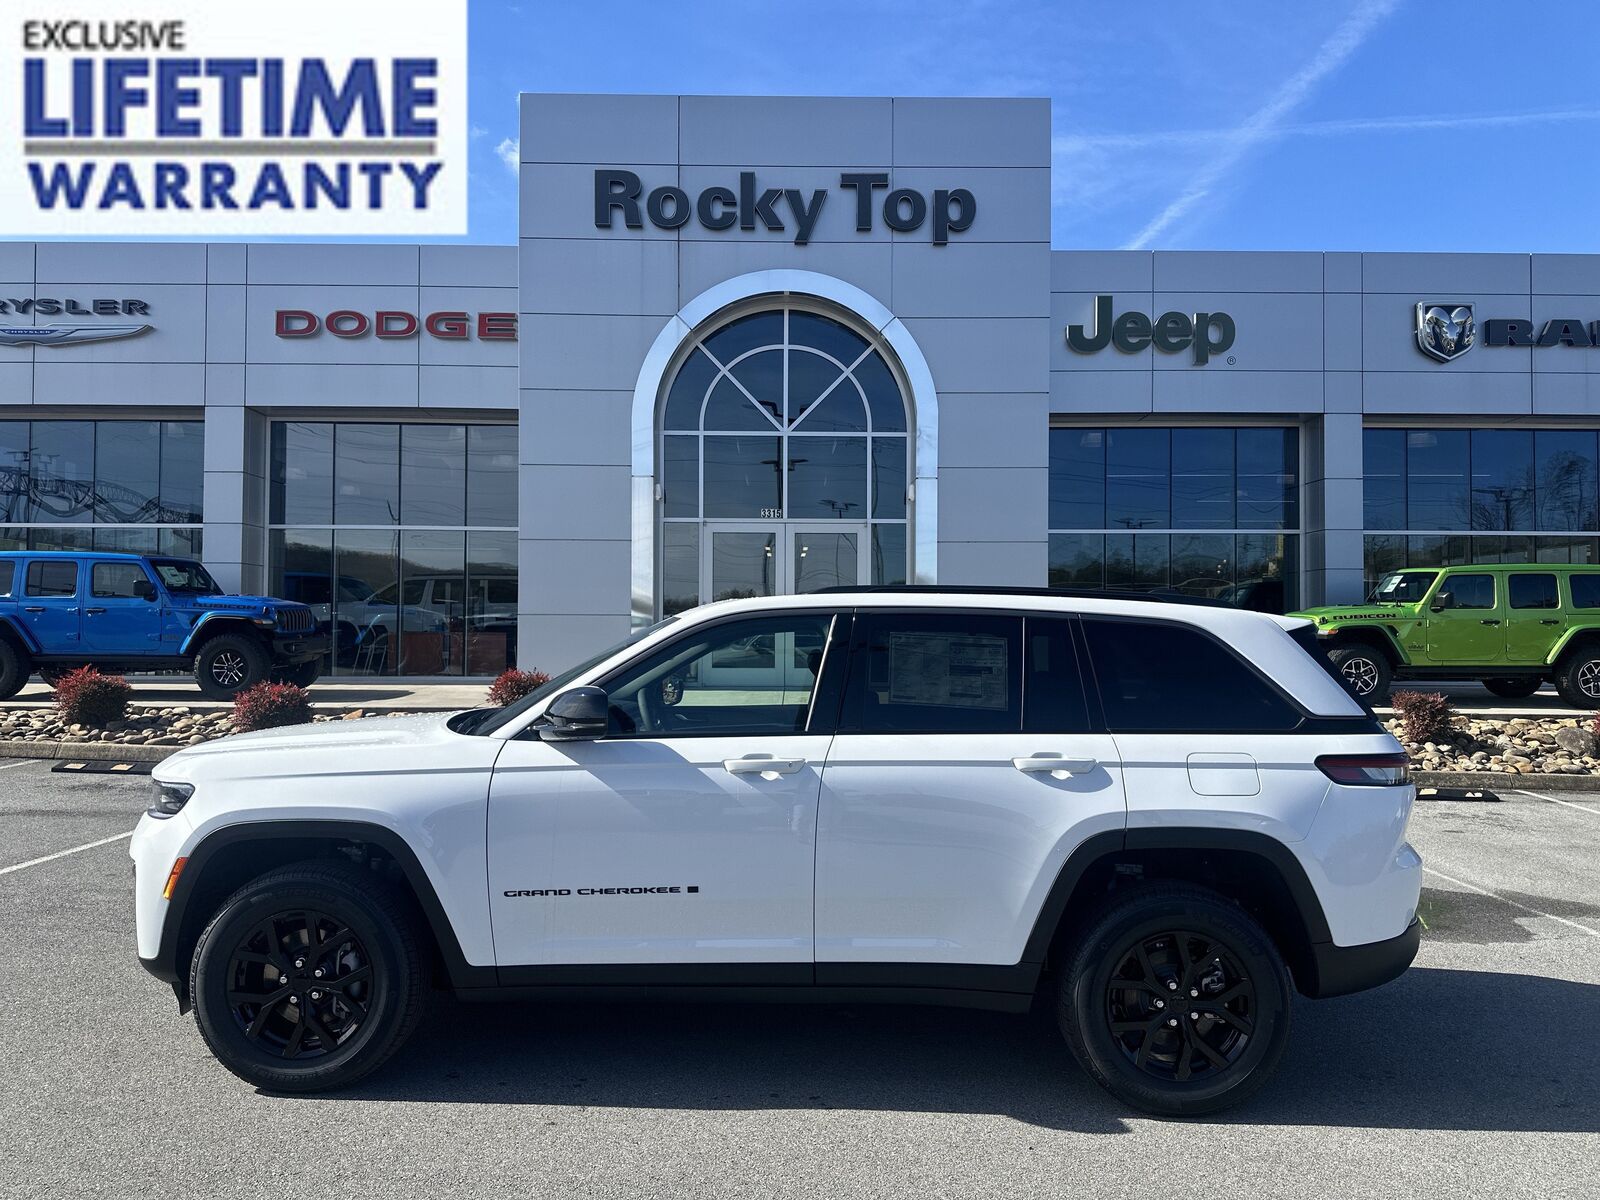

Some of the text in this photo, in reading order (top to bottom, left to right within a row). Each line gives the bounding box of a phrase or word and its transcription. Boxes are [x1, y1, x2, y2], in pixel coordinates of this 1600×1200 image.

[594, 168, 977, 247] Rocky Top
[0, 298, 148, 316] YSLER
[275, 309, 518, 341] DODGE
[1065, 295, 1236, 366] Jeep
[1484, 318, 1600, 347] RA
[761, 508, 782, 518] 3315
[1333, 613, 1397, 621] RUBICON
[503, 886, 681, 897] GRAND CHEROKEE
